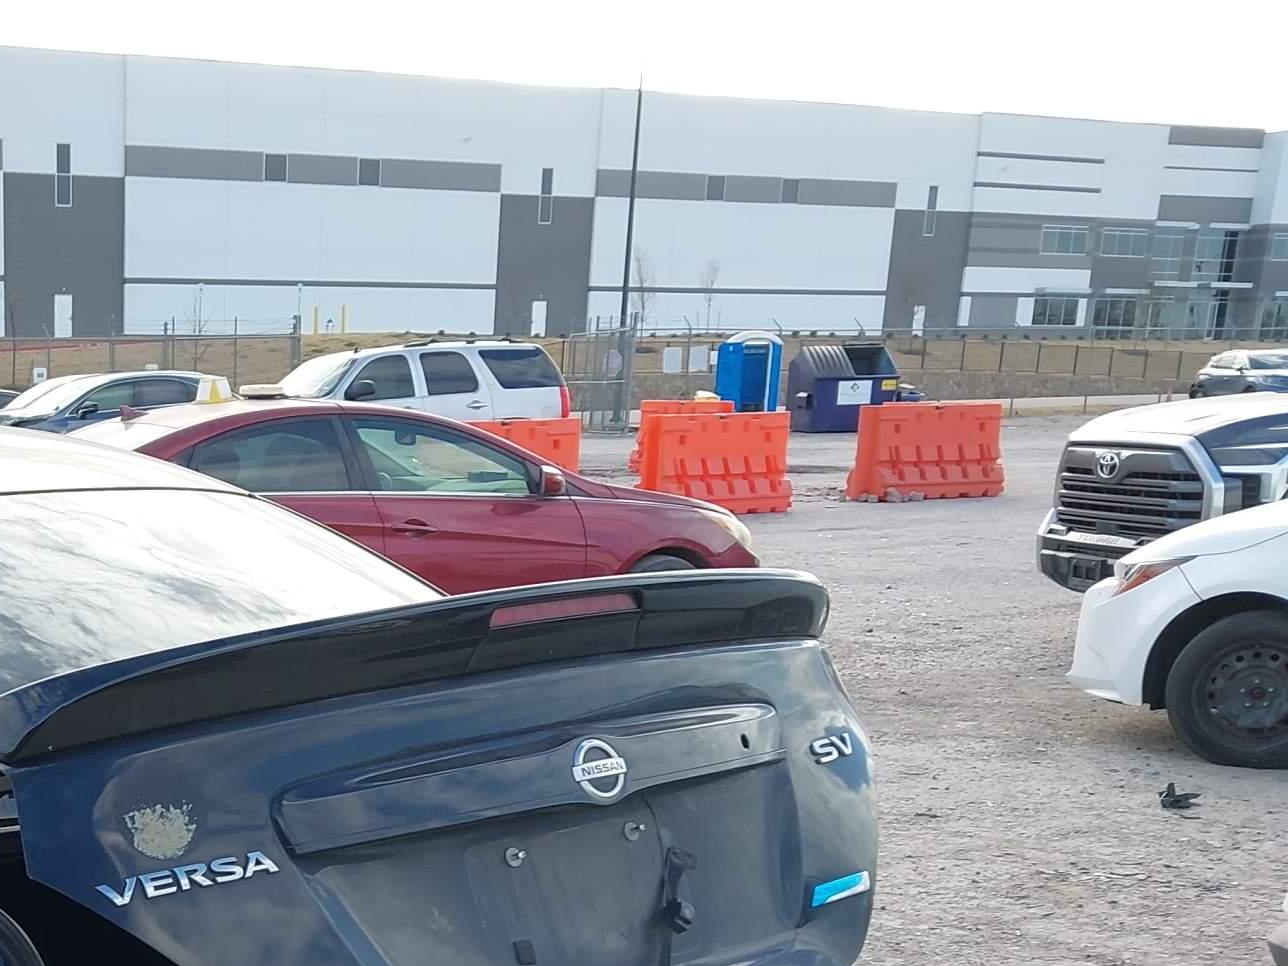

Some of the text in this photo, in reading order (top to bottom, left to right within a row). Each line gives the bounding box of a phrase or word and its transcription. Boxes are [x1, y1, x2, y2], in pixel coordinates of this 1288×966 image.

[811, 732, 853, 764] SV
[581, 760, 624, 777] NISSAN
[94, 850, 280, 907] VERSA
